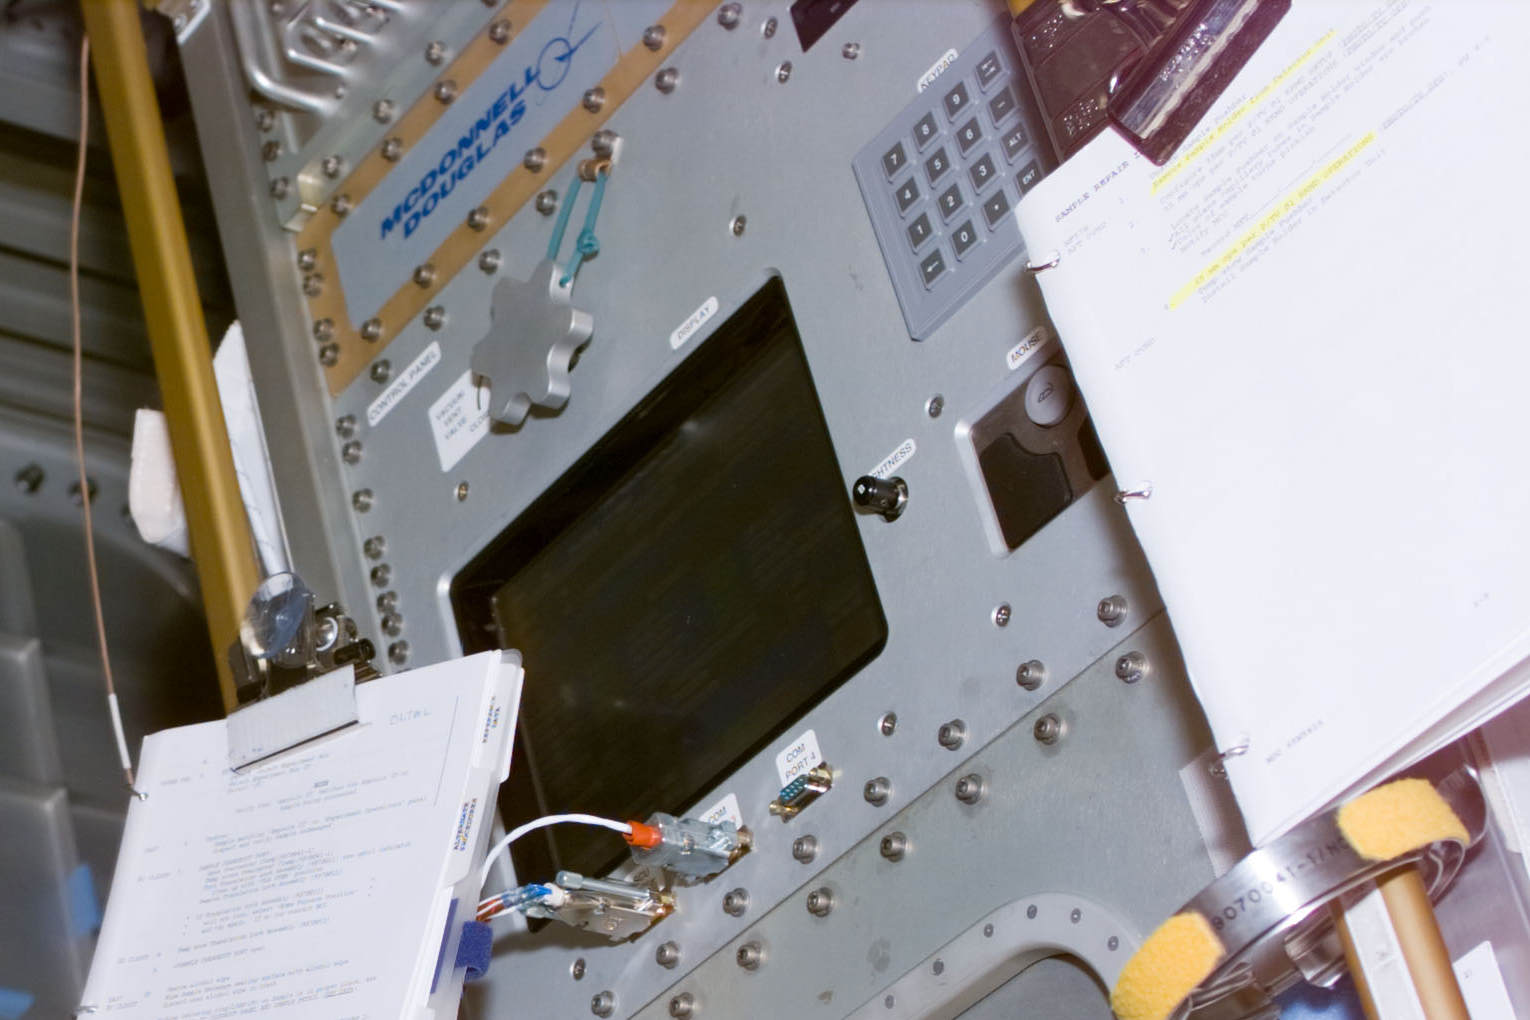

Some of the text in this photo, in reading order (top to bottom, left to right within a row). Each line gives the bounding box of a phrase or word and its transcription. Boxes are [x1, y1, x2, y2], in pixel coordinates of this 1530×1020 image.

[920, 53, 956, 89] KEYPAD
[890, 94, 961, 166] 7 8 9
[381, 66, 541, 240] MCDONNELL
[404, 99, 527, 240] DOUGLAS
[904, 129, 974, 200] 4 5 6
[917, 132, 1022, 236] 1 2 3 ALT
[1022, 169, 1036, 185] ENT
[1054, 191, 1090, 223] SAMPLE
[961, 231, 968, 243] 0
[1011, 334, 1041, 363] MOUSE
[785, 757, 809, 781] PORT
[786, 743, 806, 764] COM
